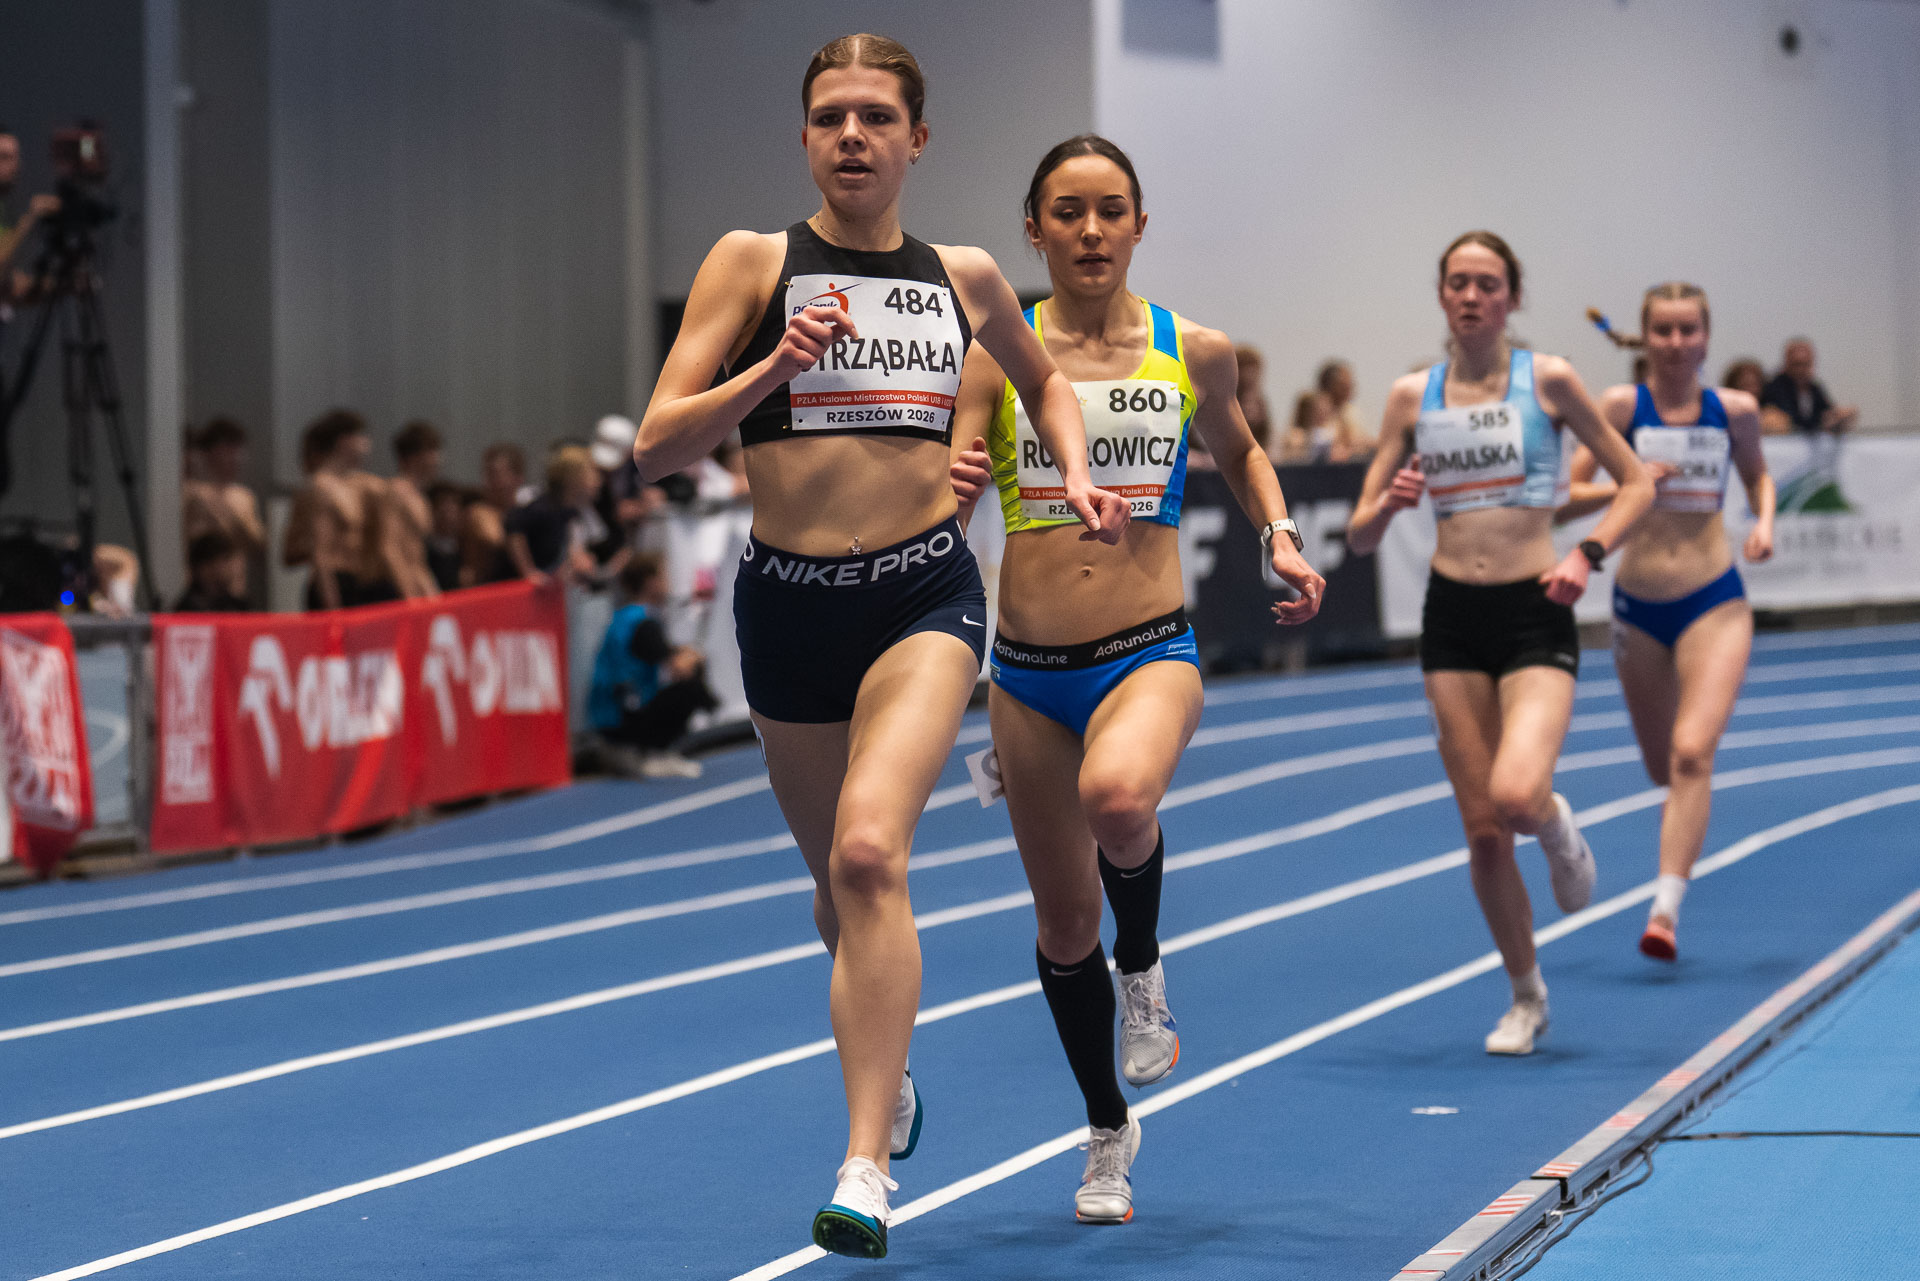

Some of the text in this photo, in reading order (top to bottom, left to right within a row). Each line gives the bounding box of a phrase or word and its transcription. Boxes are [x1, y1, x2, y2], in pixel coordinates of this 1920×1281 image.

[884, 287, 944, 318] 484
[801, 338, 957, 377] RZĄBAŁA
[796, 396, 817, 405] PZLA
[819, 395, 852, 404] Halowe
[854, 393, 906, 403] Mistrzostwa
[907, 393, 930, 403] Polski
[1109, 387, 1167, 413] 860
[826, 406, 936, 424] RZESZÓW 2026
[1469, 407, 1510, 431] 585
[1023, 489, 1067, 498] PZLA Halow
[1121, 487, 1144, 496] Polski
[1130, 501, 1154, 512] 026
[761, 531, 954, 587] NIKE PRO
[1094, 621, 1178, 660] AdRunaLine
